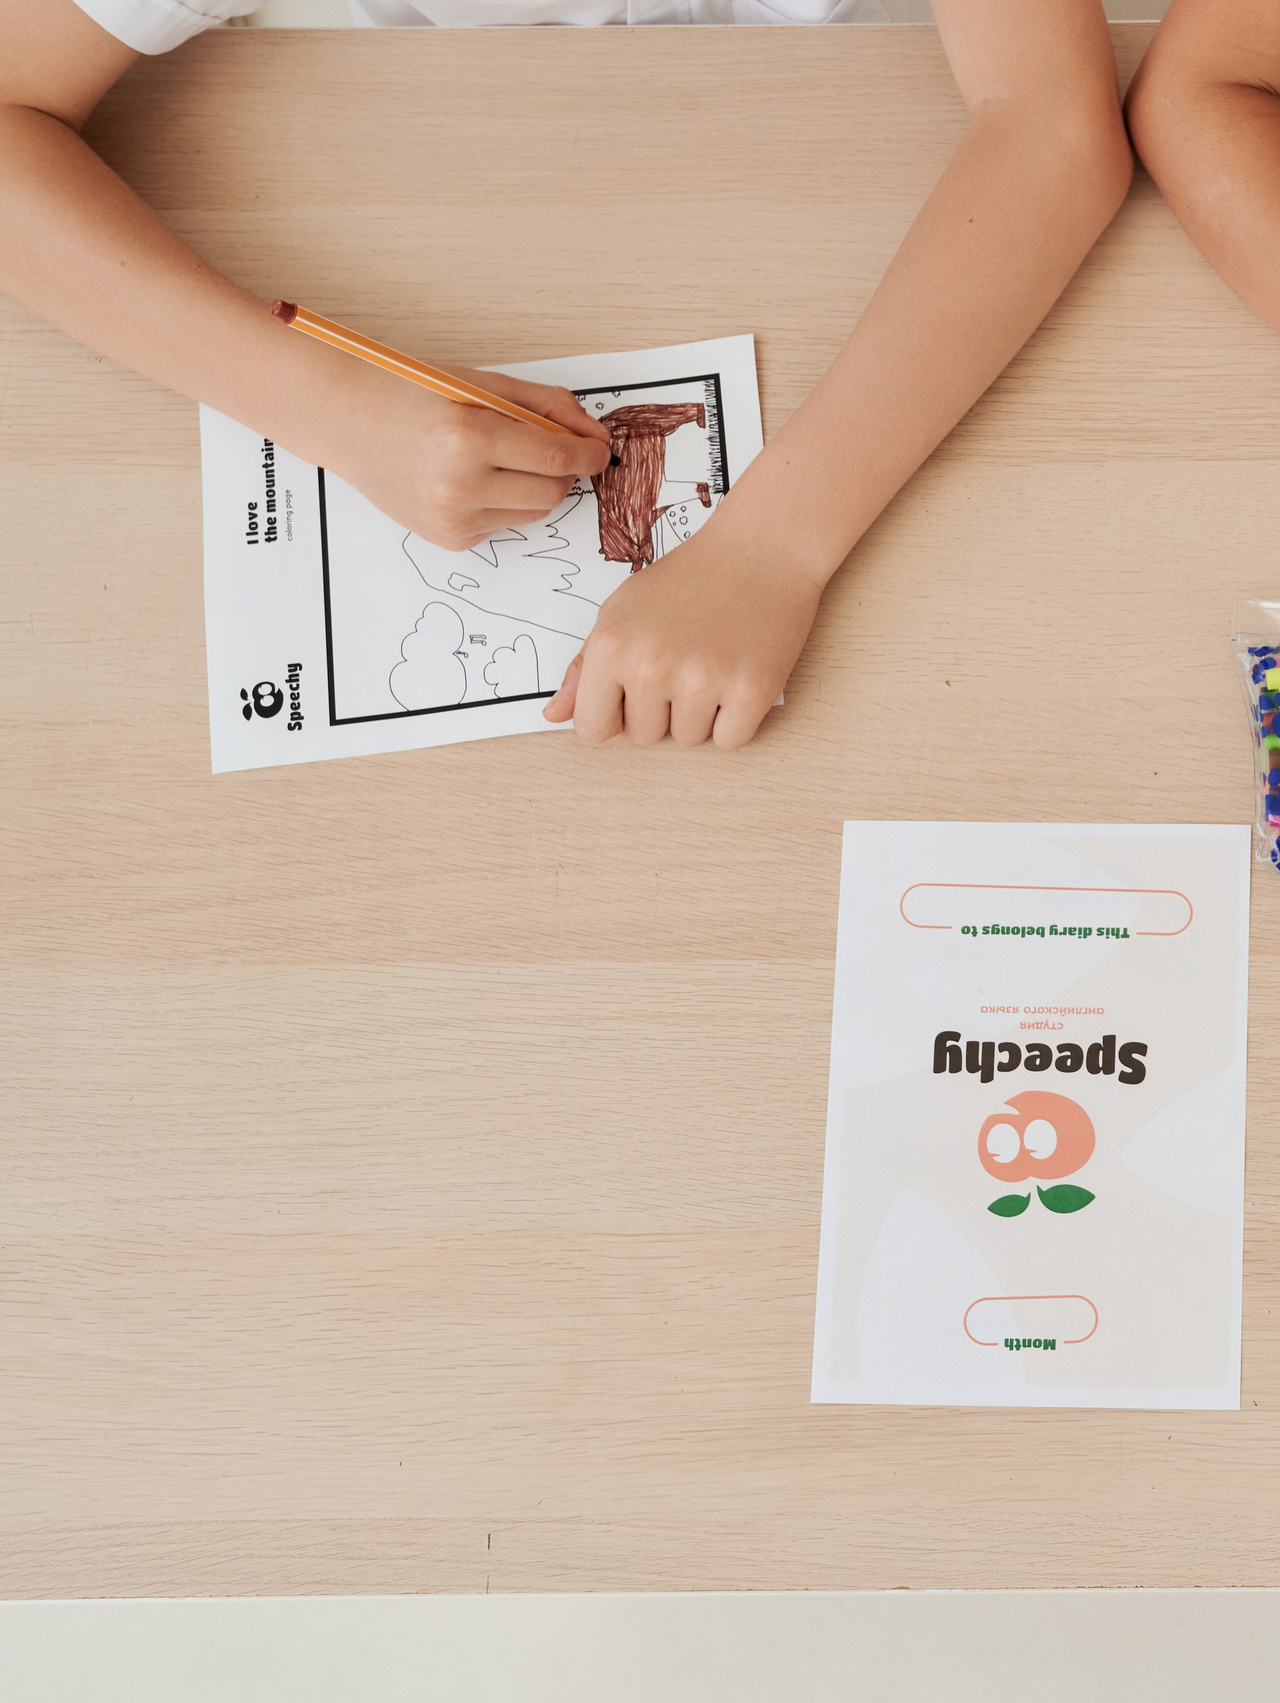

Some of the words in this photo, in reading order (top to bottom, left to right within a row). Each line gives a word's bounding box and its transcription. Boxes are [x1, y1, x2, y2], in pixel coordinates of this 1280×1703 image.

[285, 489, 294, 509] page
[245, 501, 259, 536] love
[285, 510, 294, 542] coloring
[264, 516, 278, 543] the
[285, 662, 304, 732] Speechy
[960, 925, 978, 938] to
[980, 923, 1046, 938] belongs
[1048, 924, 1094, 939] diary
[1097, 926, 1131, 939] This
[980, 1005, 1020, 1015] языка
[1023, 1005, 1106, 1017] английского
[1019, 1018, 1064, 1030] студия
[933, 1030, 1149, 1085] Speechy
[1004, 1338, 1057, 1351] Month
